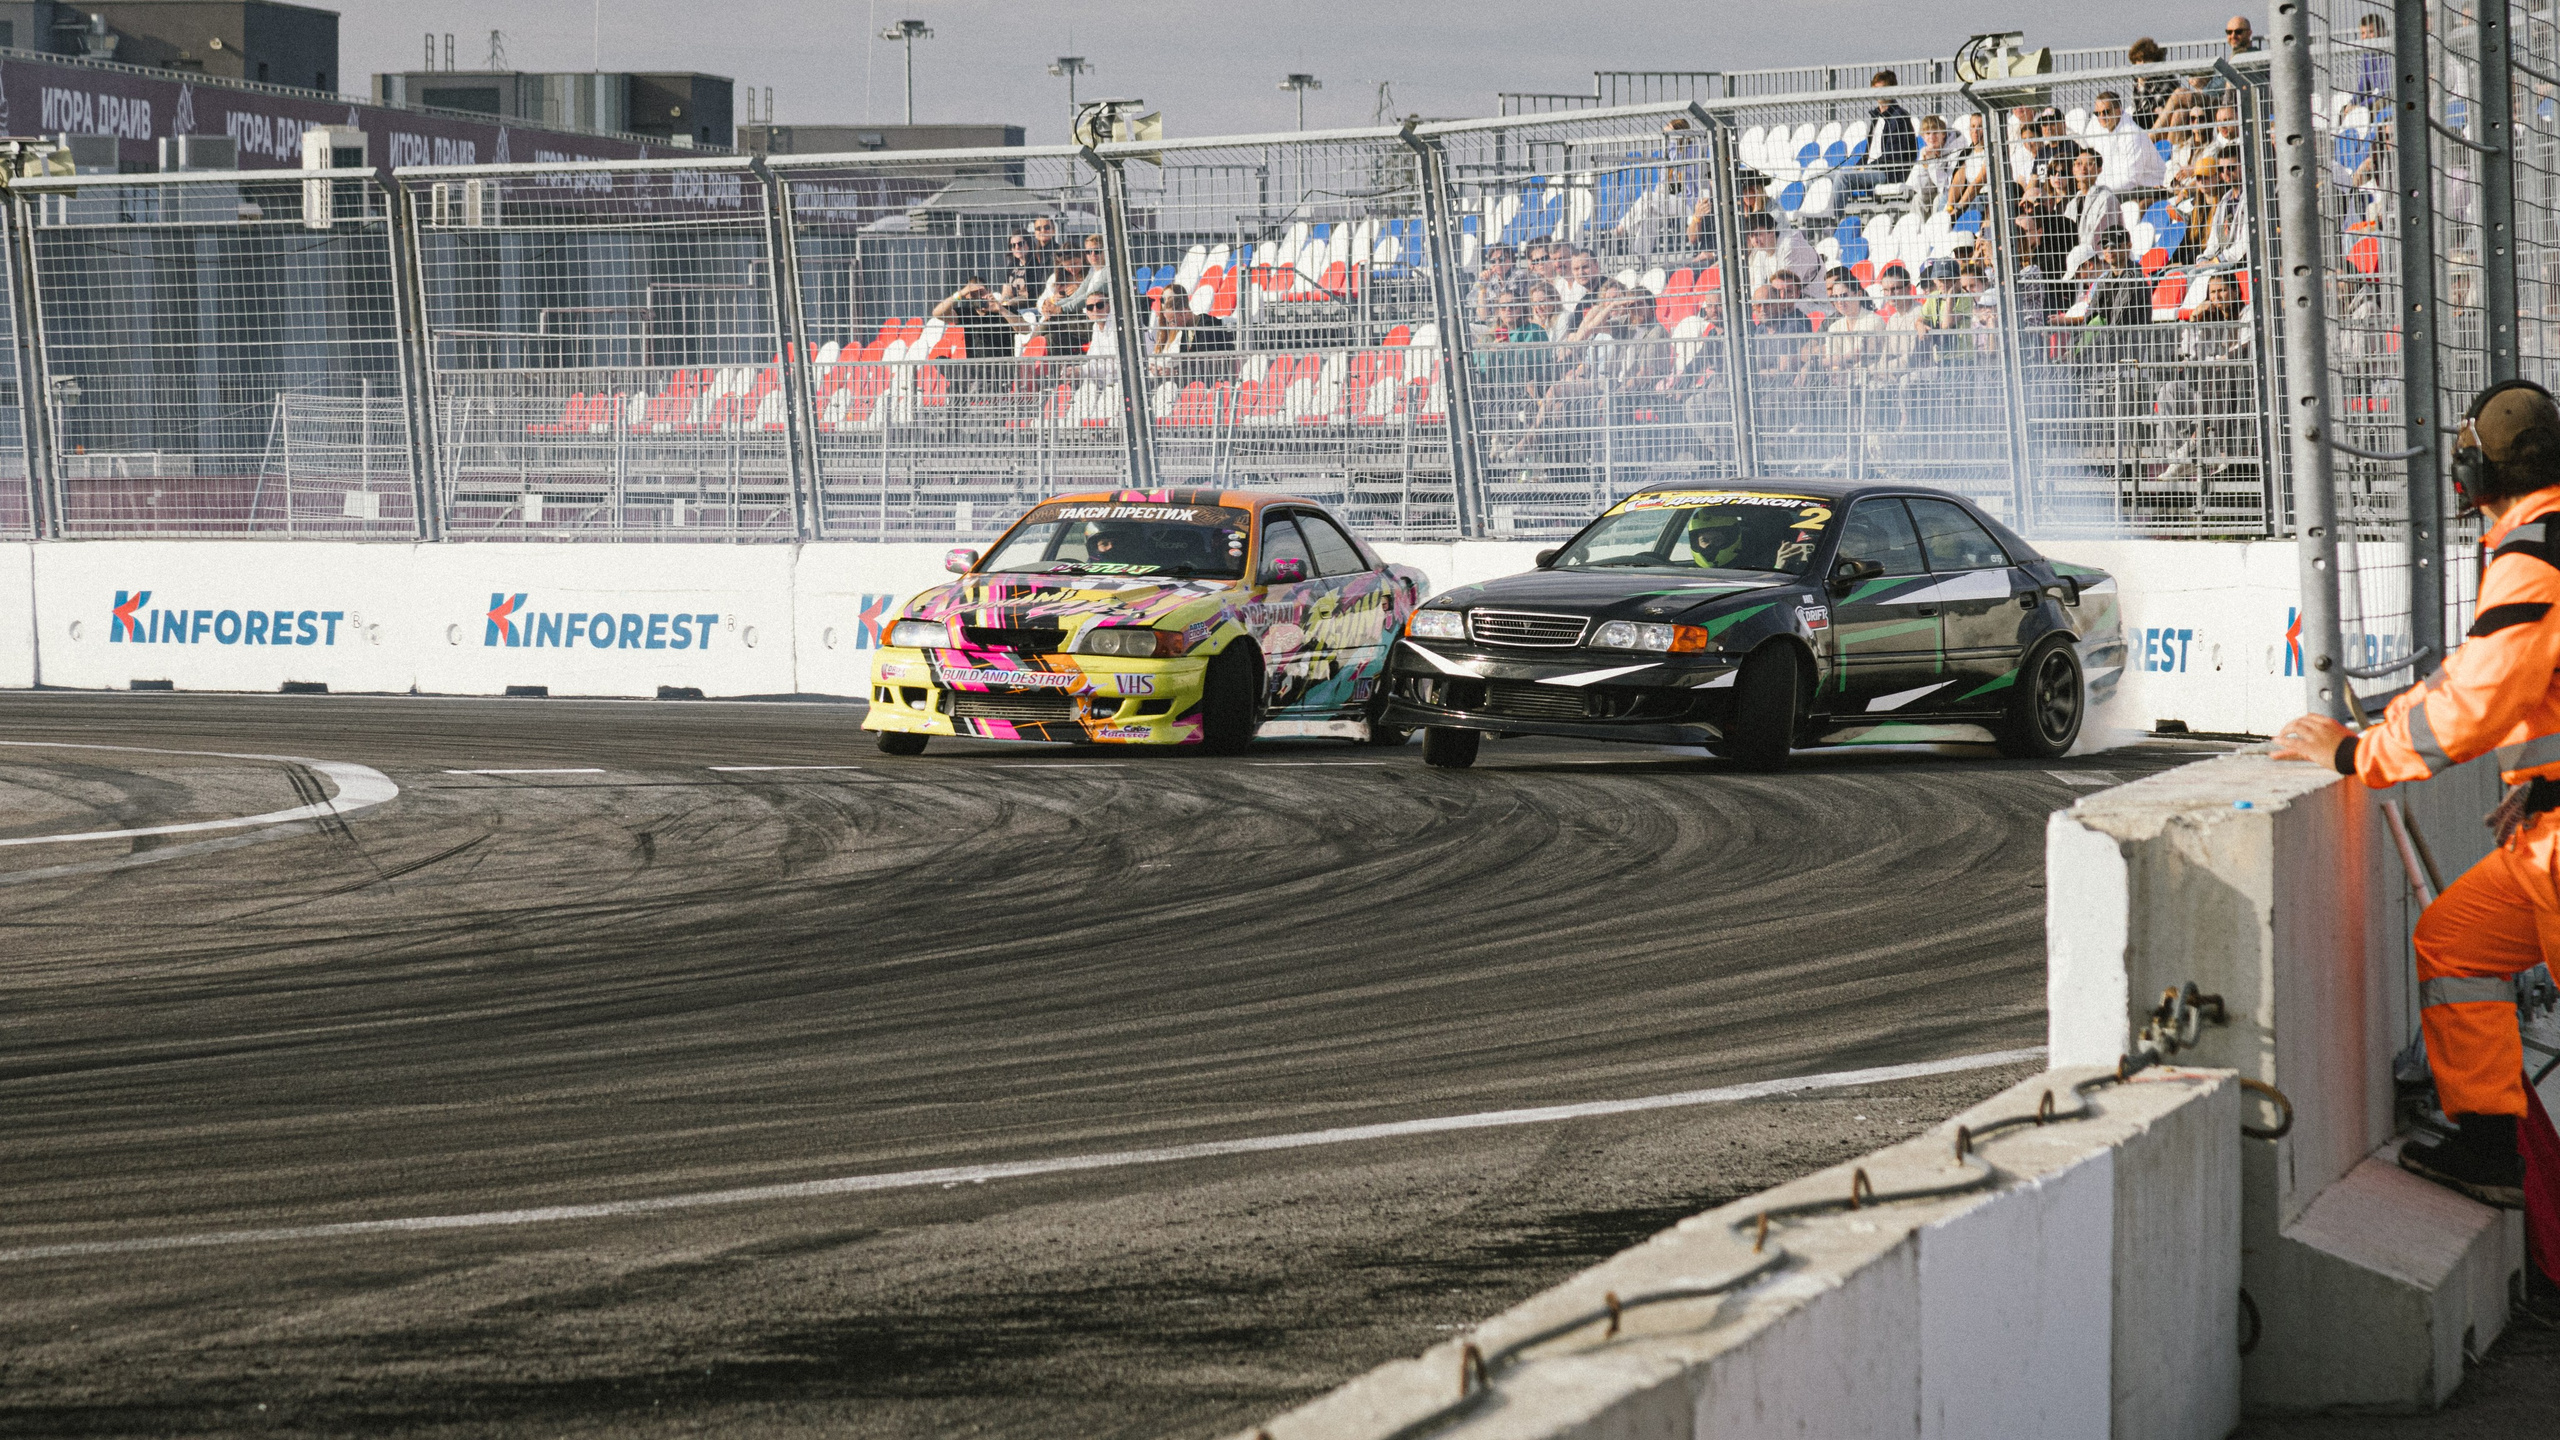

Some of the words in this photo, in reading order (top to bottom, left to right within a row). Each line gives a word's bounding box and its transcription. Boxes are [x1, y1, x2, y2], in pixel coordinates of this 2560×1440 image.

[42, 86, 94, 133] ИГОРА
[226, 110, 274, 155] ИГОРА
[275, 116, 322, 162] ДРА
[389, 131, 430, 169] ИГОРА
[1666, 495, 1738, 507] ДРИФТ
[1736, 498, 1802, 508] ТАКСИ
[1058, 506, 1111, 519] ТАКСИ
[1110, 506, 1198, 521] ПРЕСТИЖ
[1790, 507, 1832, 530] 2
[110, 590, 344, 645] KINFOREST
[484, 593, 718, 649] KINFOREST
[1805, 609, 1826, 621] DRIFT
[1189, 622, 1205, 631] АВТО
[1189, 628, 1209, 639] СПОРТ
[943, 669, 979, 680] BUILD
[982, 670, 1009, 682] AND
[1011, 672, 1076, 686] DESTROY
[1116, 675, 1154, 695] VHS
